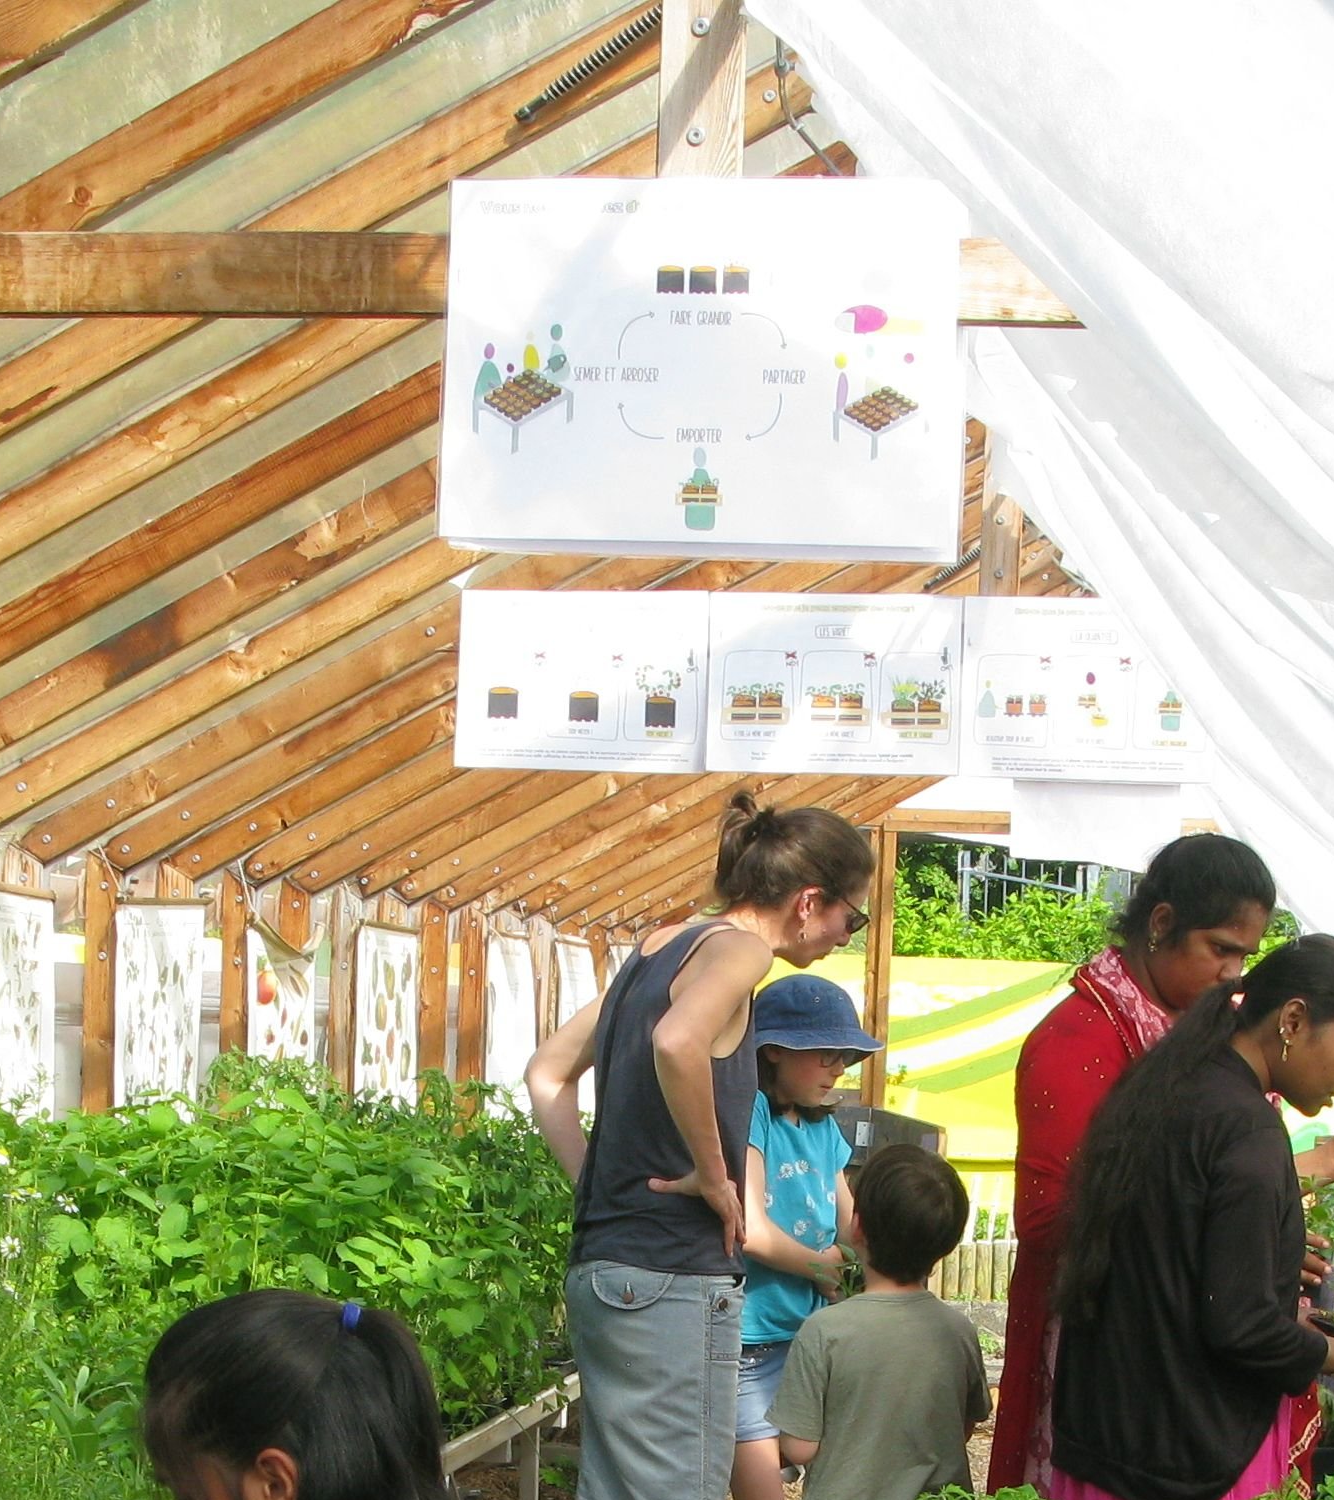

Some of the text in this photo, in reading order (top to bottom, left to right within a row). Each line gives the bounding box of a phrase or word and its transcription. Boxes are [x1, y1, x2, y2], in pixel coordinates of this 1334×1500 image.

[670, 310, 732, 326] FAIRE GRANDIR
[573, 367, 660, 382] SEMER ET ARROSER
[762, 369, 806, 385] PARTAGER
[676, 428, 722, 443] EMPORTER
